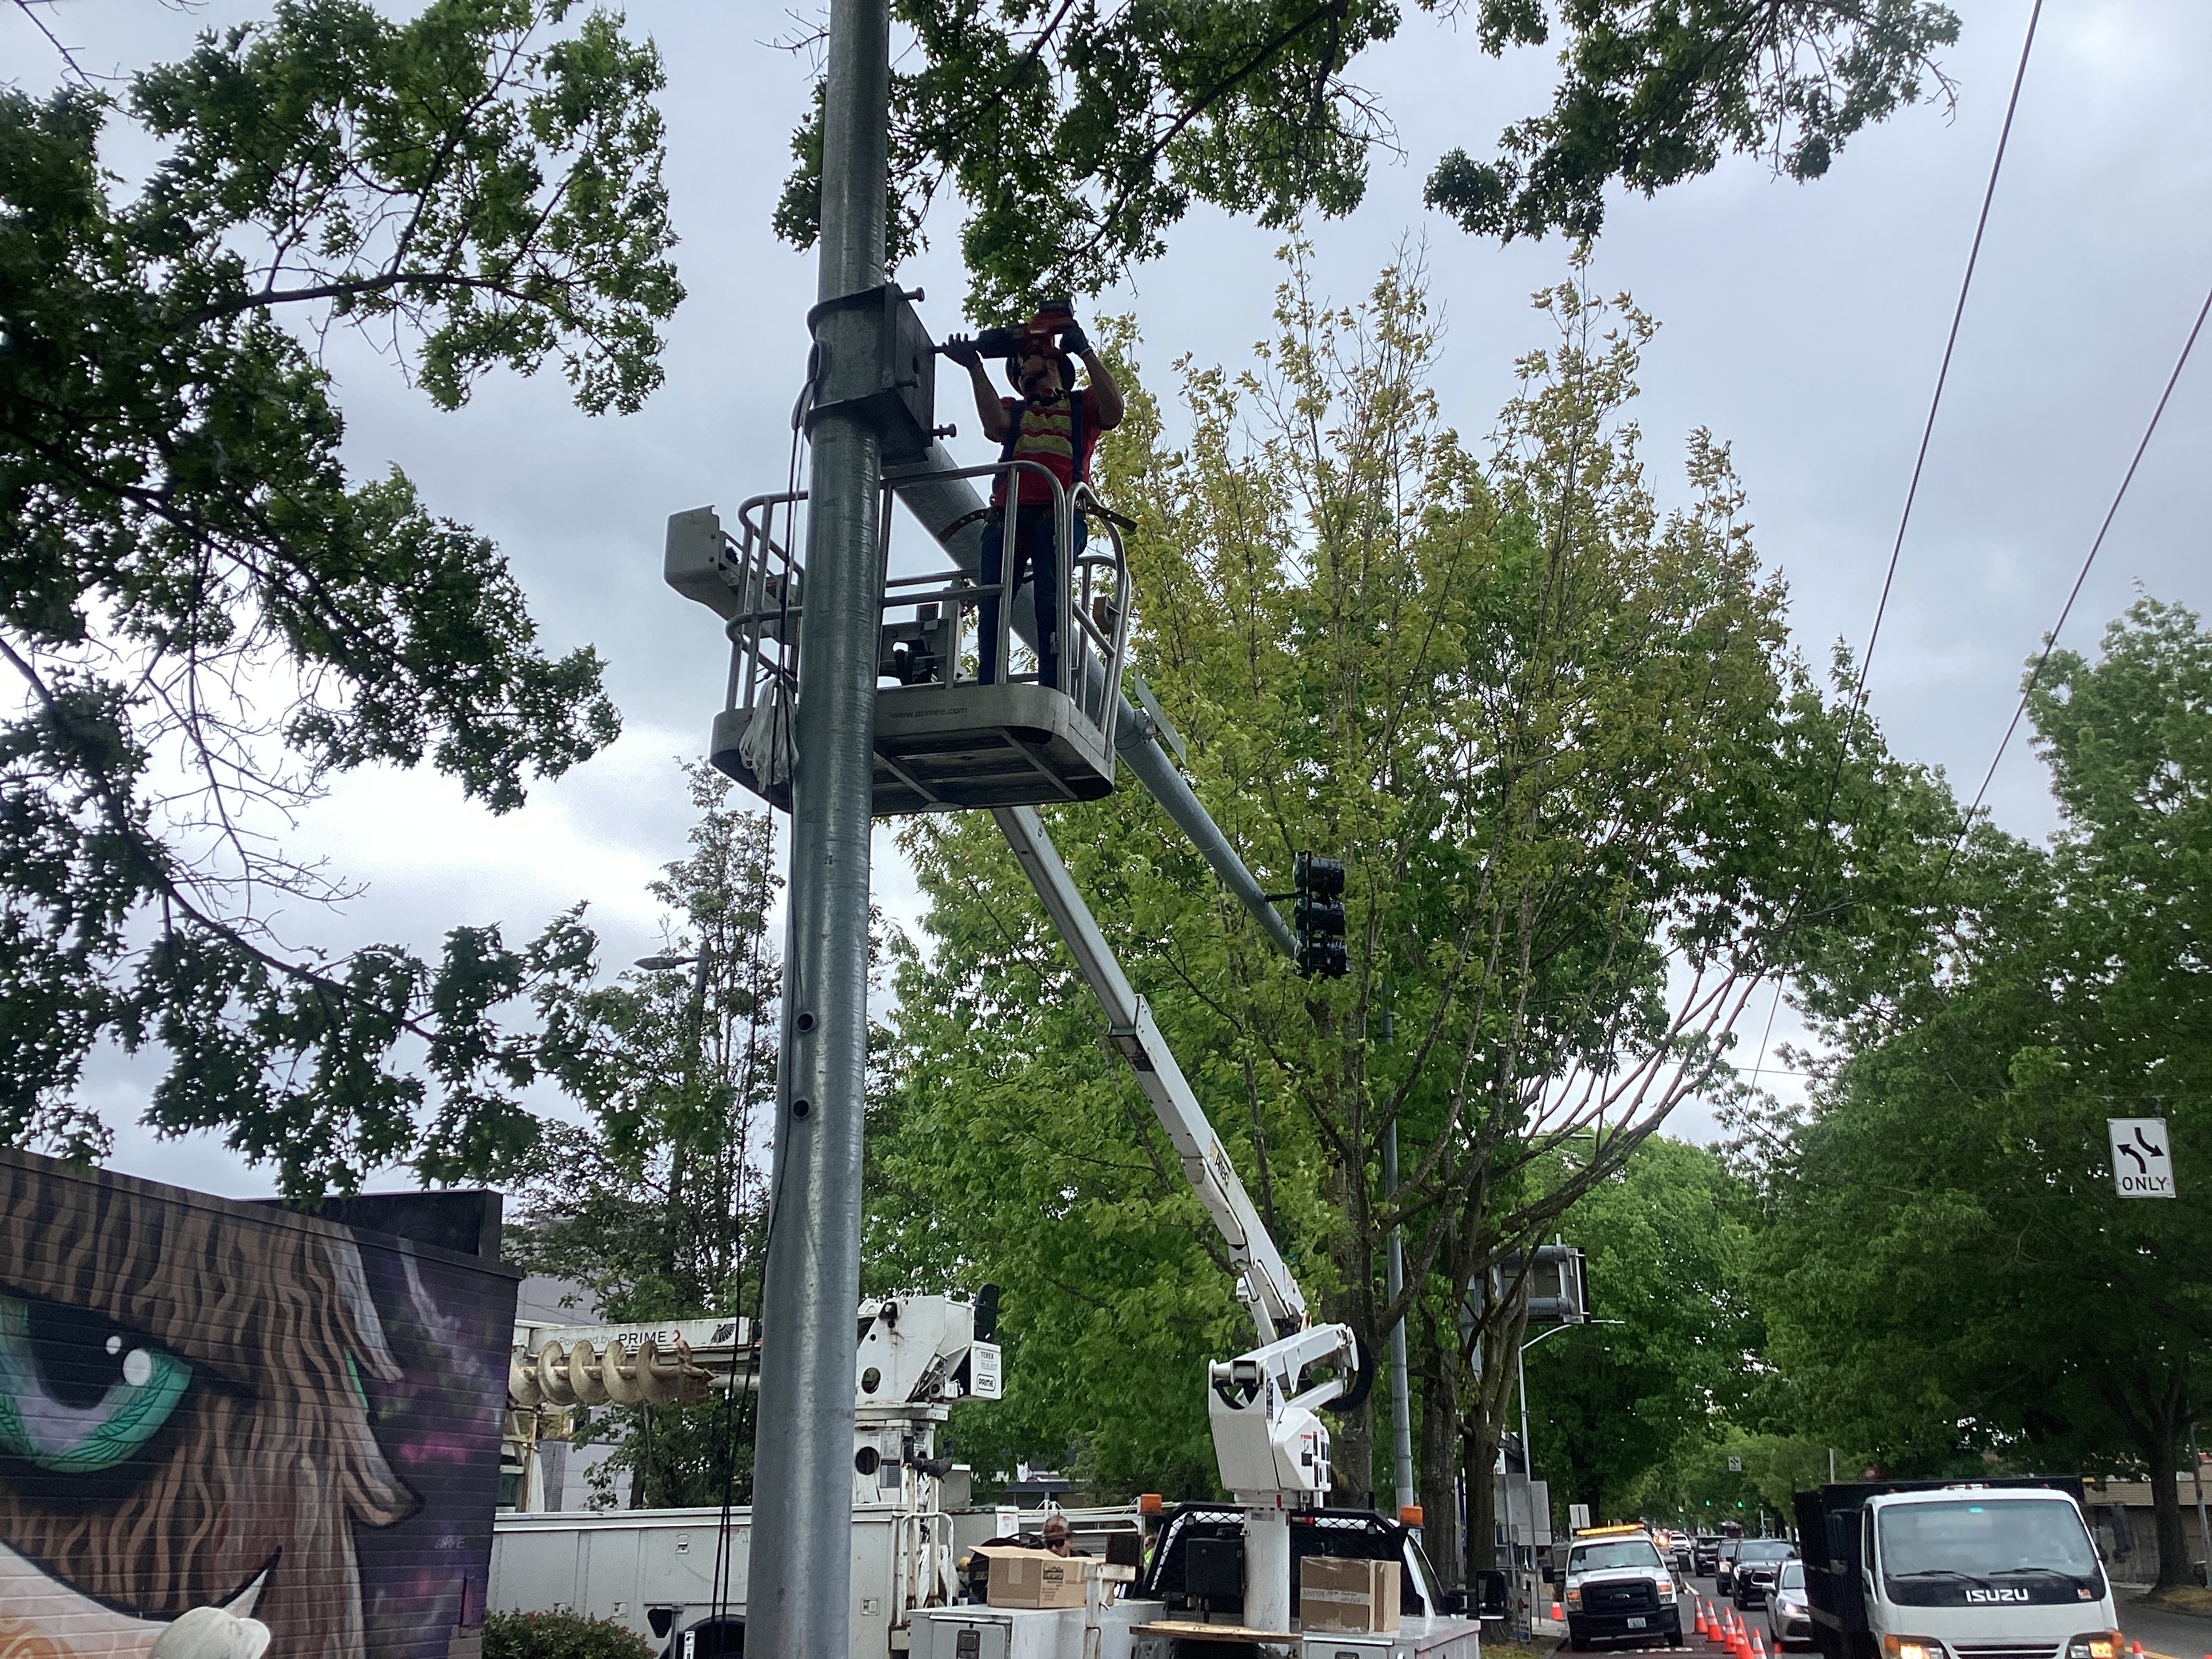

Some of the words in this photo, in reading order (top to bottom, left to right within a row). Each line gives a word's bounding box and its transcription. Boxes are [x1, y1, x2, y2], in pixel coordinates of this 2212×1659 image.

[2122, 1176, 2167, 1191] ONLY
[618, 1330, 667, 1345] PRIME
[981, 1351, 994, 1359] TEREX
[1966, 1589, 2029, 1602] ISUZU
